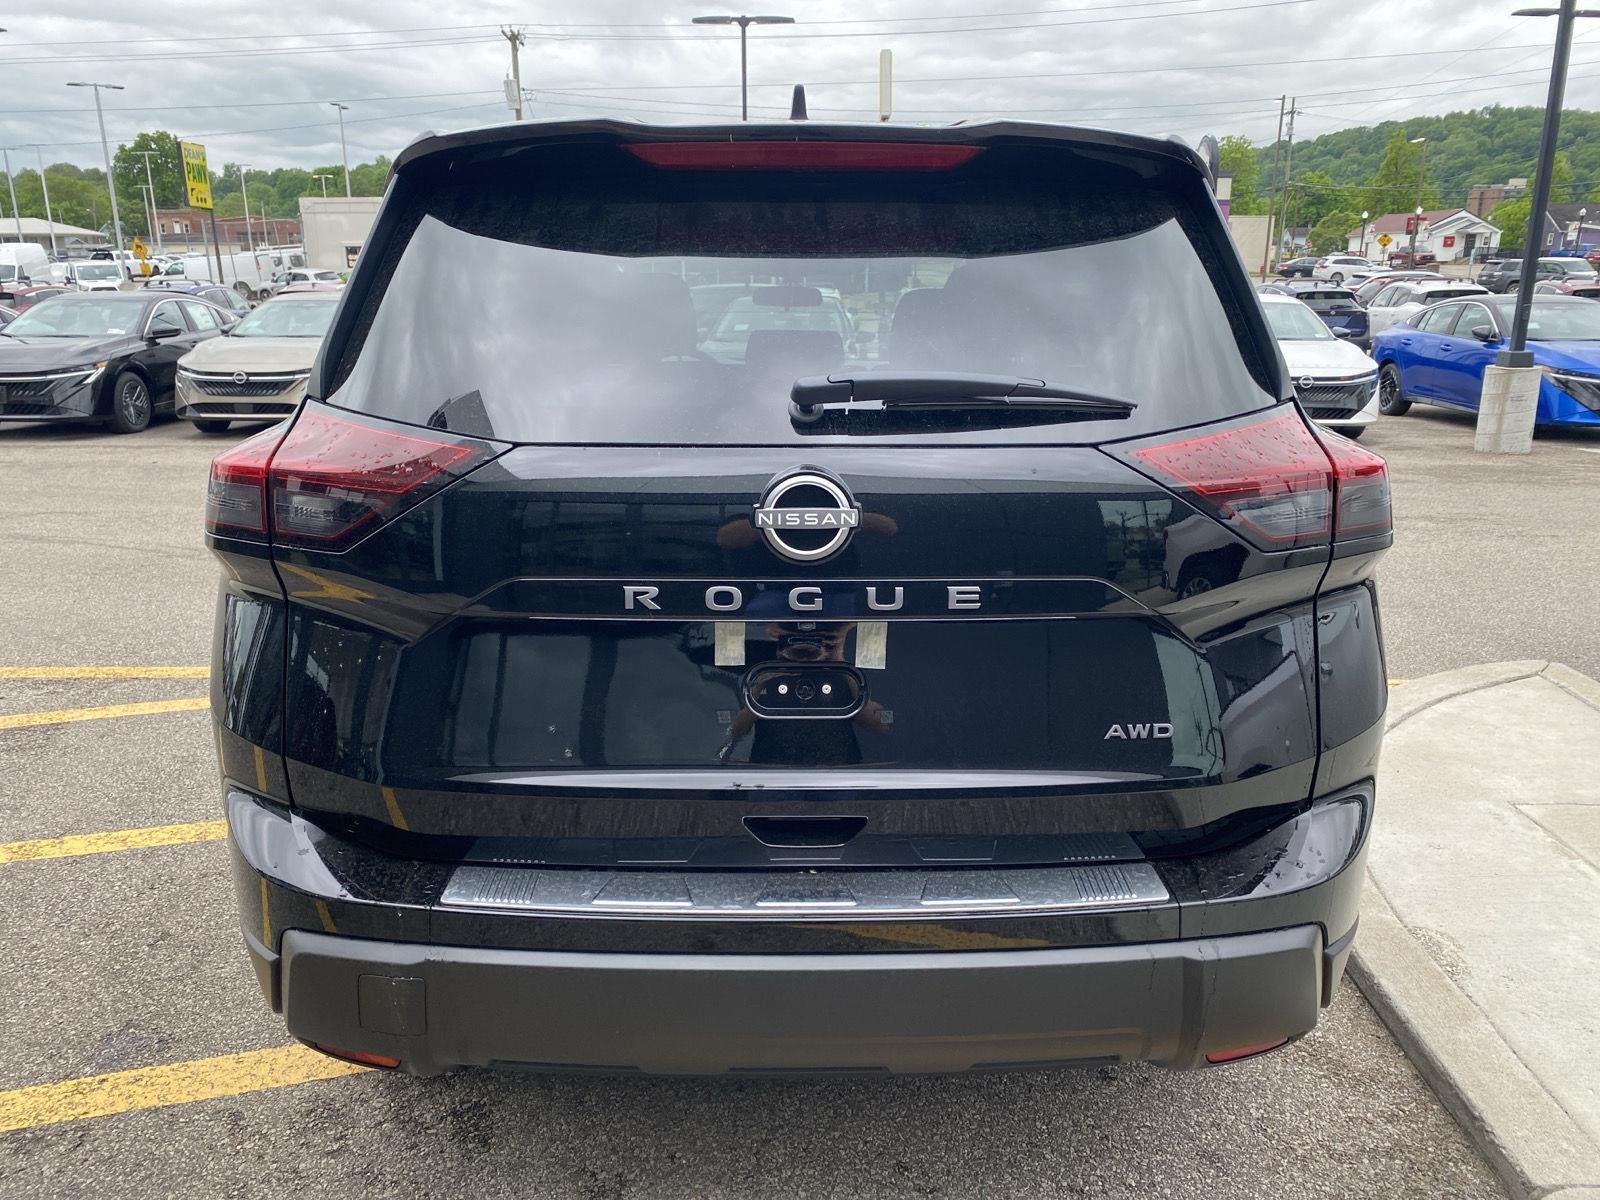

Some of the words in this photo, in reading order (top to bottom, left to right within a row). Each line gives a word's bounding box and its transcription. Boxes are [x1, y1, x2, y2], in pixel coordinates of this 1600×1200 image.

[186, 161, 208, 184] PAWN
[758, 513, 856, 525] NISSAN
[622, 585, 982, 611] ROGUE
[1103, 722, 1174, 740] AWD
